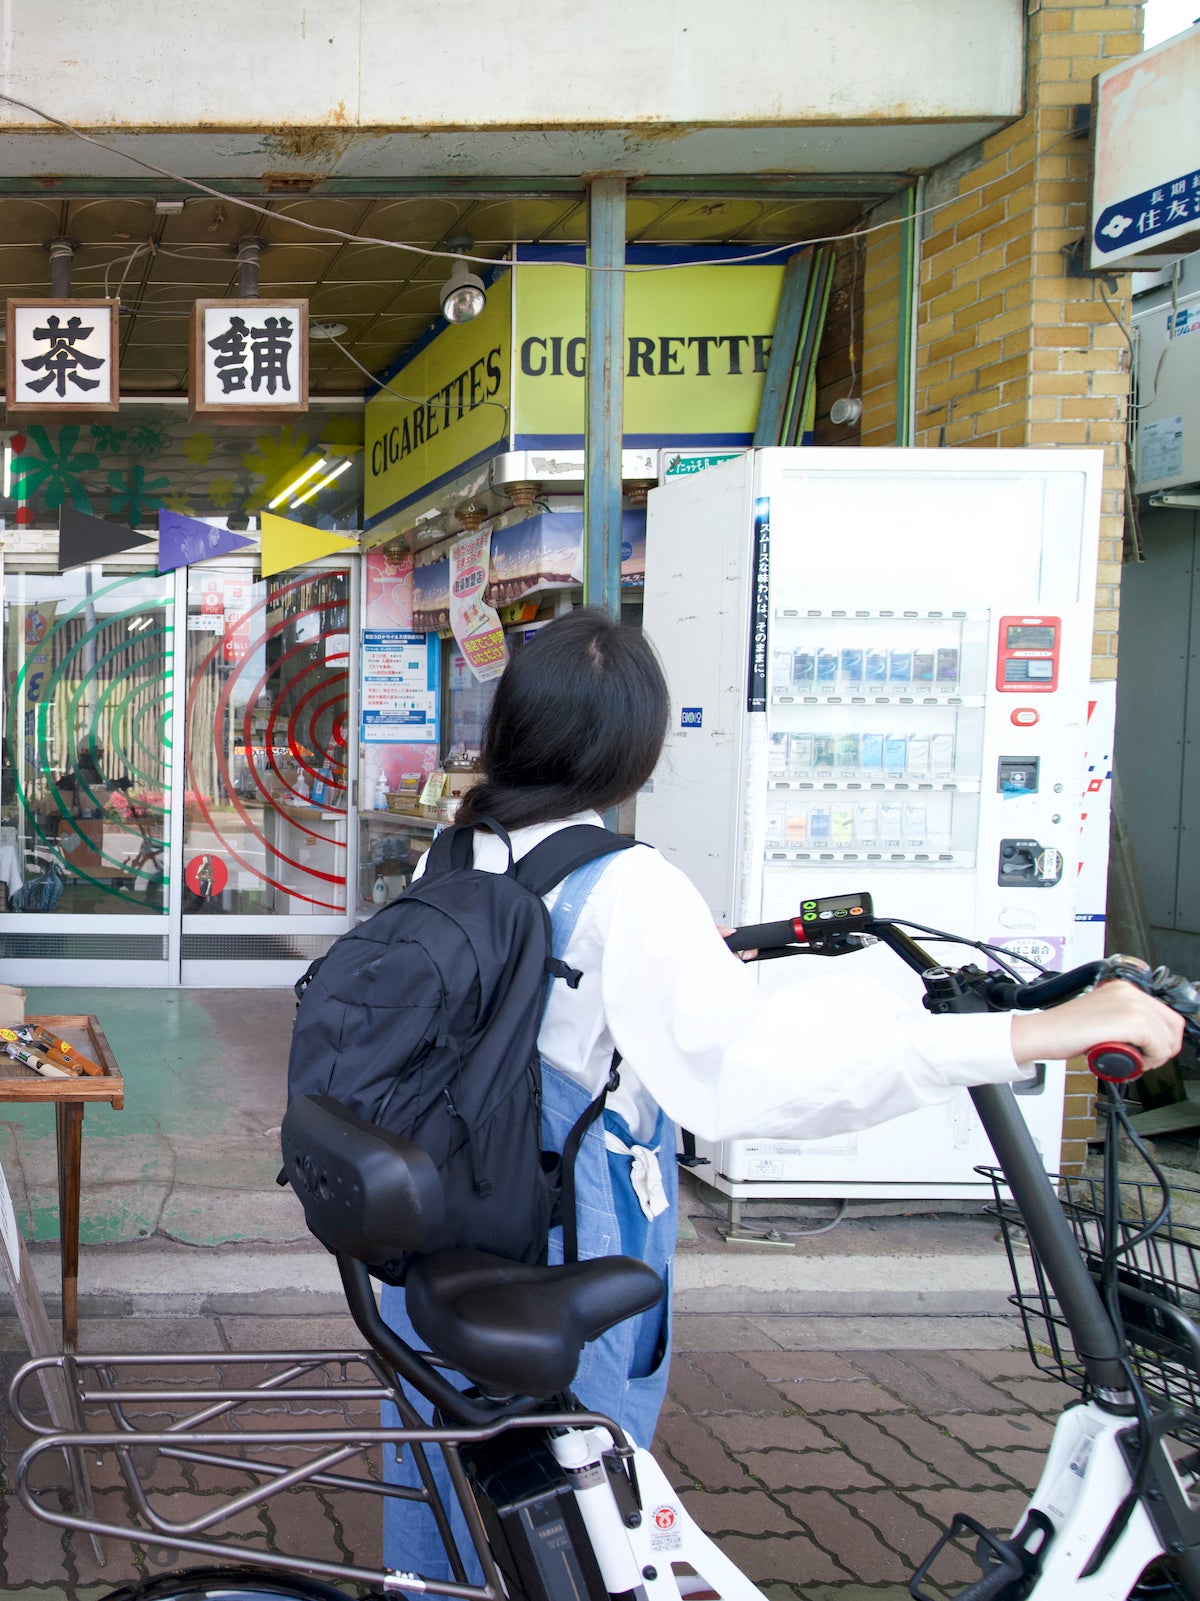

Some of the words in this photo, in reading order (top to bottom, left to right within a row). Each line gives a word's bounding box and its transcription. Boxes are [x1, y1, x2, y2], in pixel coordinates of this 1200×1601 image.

[21, 315, 105, 397] 茶
[208, 316, 293, 395] 舗
[372, 343, 502, 477] CIGARETTES
